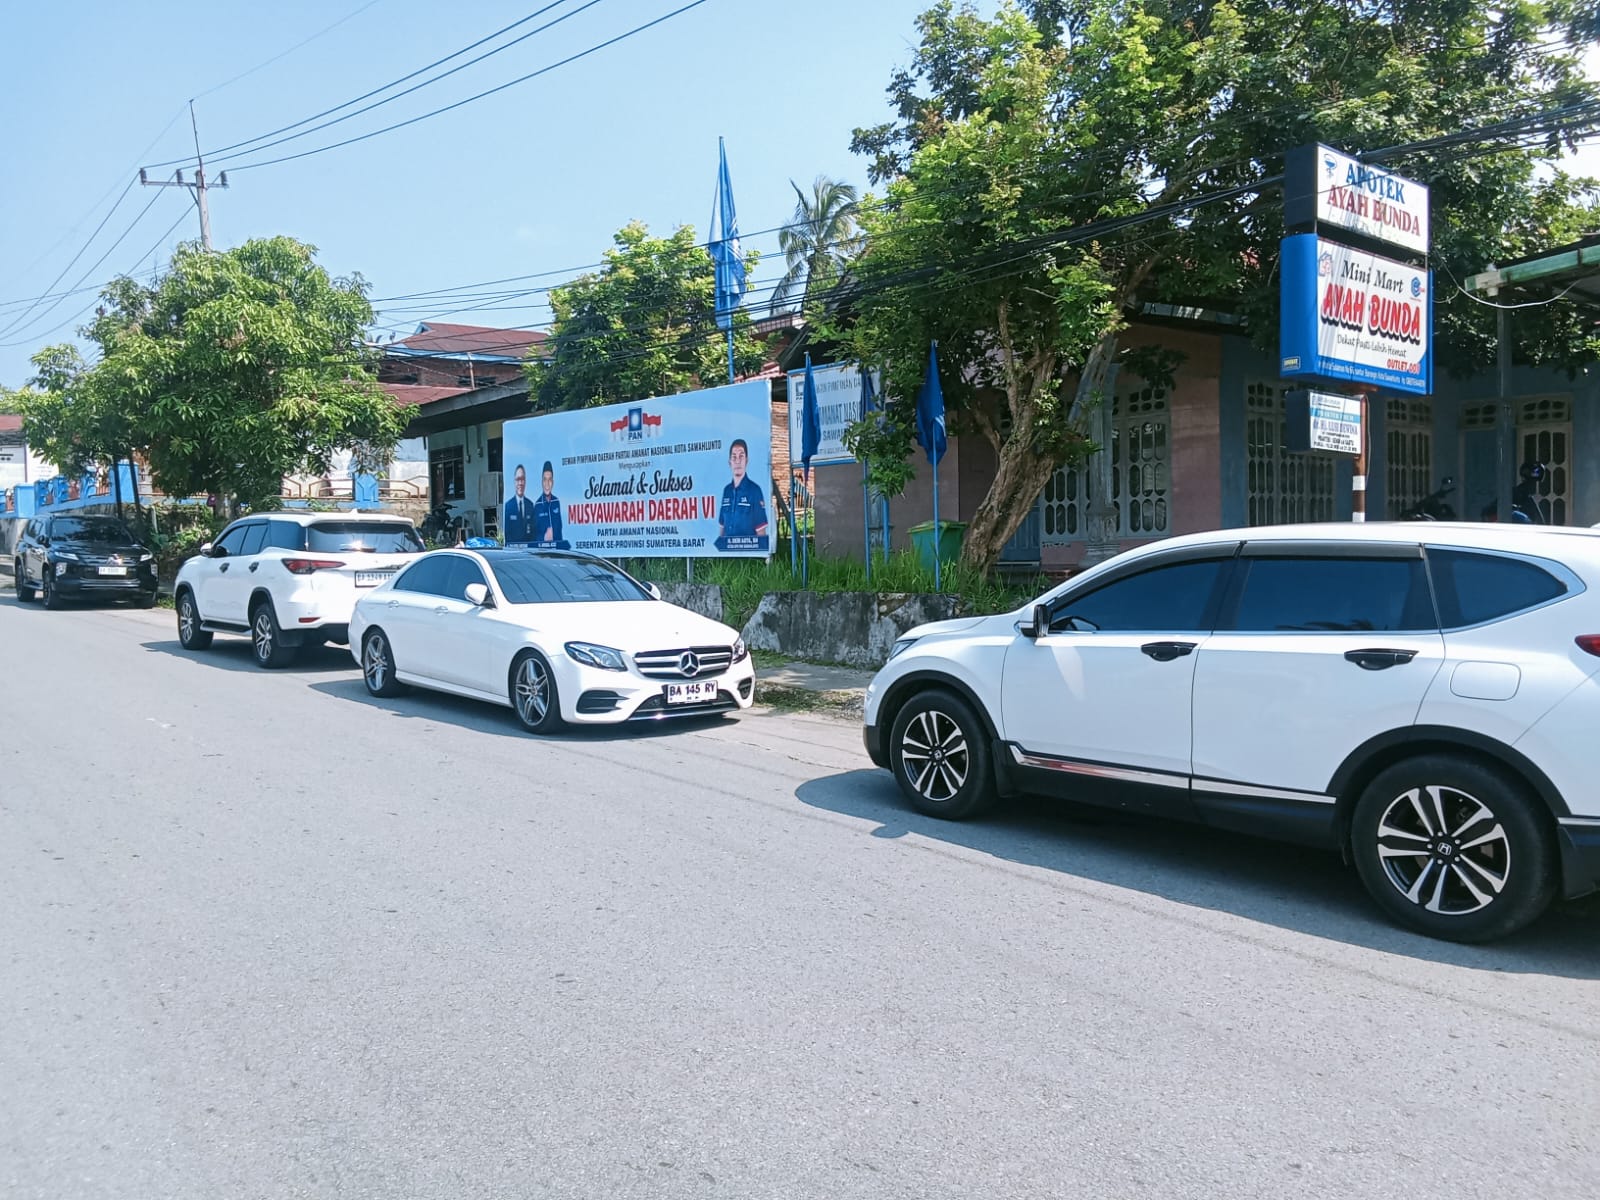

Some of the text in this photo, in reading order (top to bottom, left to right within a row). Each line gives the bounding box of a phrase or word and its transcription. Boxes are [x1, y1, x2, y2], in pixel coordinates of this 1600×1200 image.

[1346, 163, 1405, 204] APOTEK
[1327, 184, 1421, 236] AYAH BUNDA
[1341, 260, 1404, 293] Mini Mart
[1321, 283, 1421, 345] AYAH BUNDA
[628, 431, 643, 440] PAN
[651, 445, 673, 456] NASIONAL
[688, 440, 722, 452] SAWAHLUNTO
[584, 469, 693, 500] Selamat & Sukses
[568, 495, 715, 524] MUSYAWARAH DAERAH VI
[576, 538, 705, 549] SERENTAK SE-PROVINSI SUMATERA BARAT
[597, 526, 679, 537] PARTAI AMANAT NASIONAL
[670, 682, 715, 696] BA 145 RY
